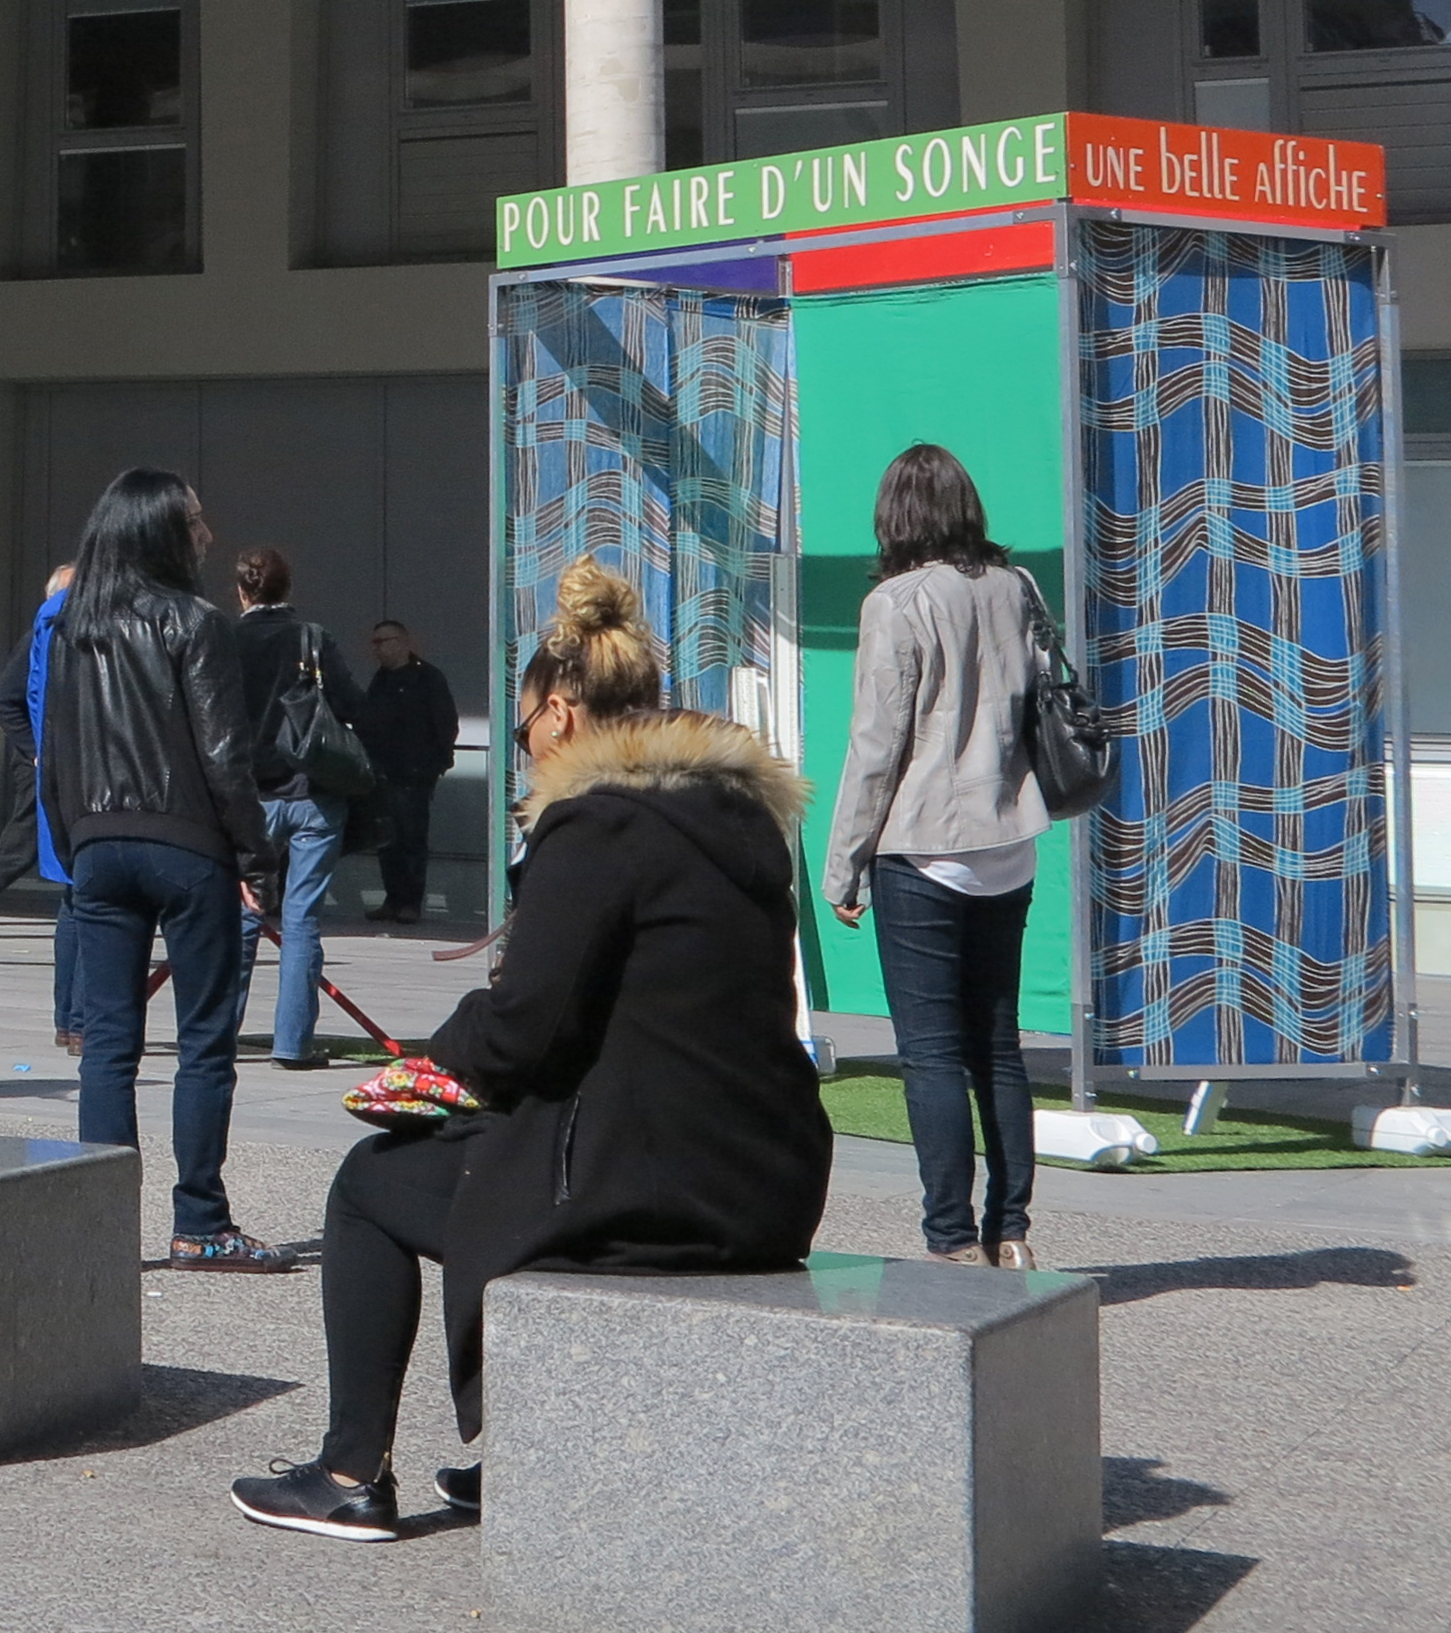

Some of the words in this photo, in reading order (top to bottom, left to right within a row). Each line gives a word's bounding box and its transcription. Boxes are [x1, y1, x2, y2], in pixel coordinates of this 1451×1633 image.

[501, 189, 603, 254] POUR
[623, 169, 737, 239] FAIRE
[760, 150, 869, 221] D'UN
[894, 120, 1058, 204] SONGE
[1085, 142, 1146, 192] UNE
